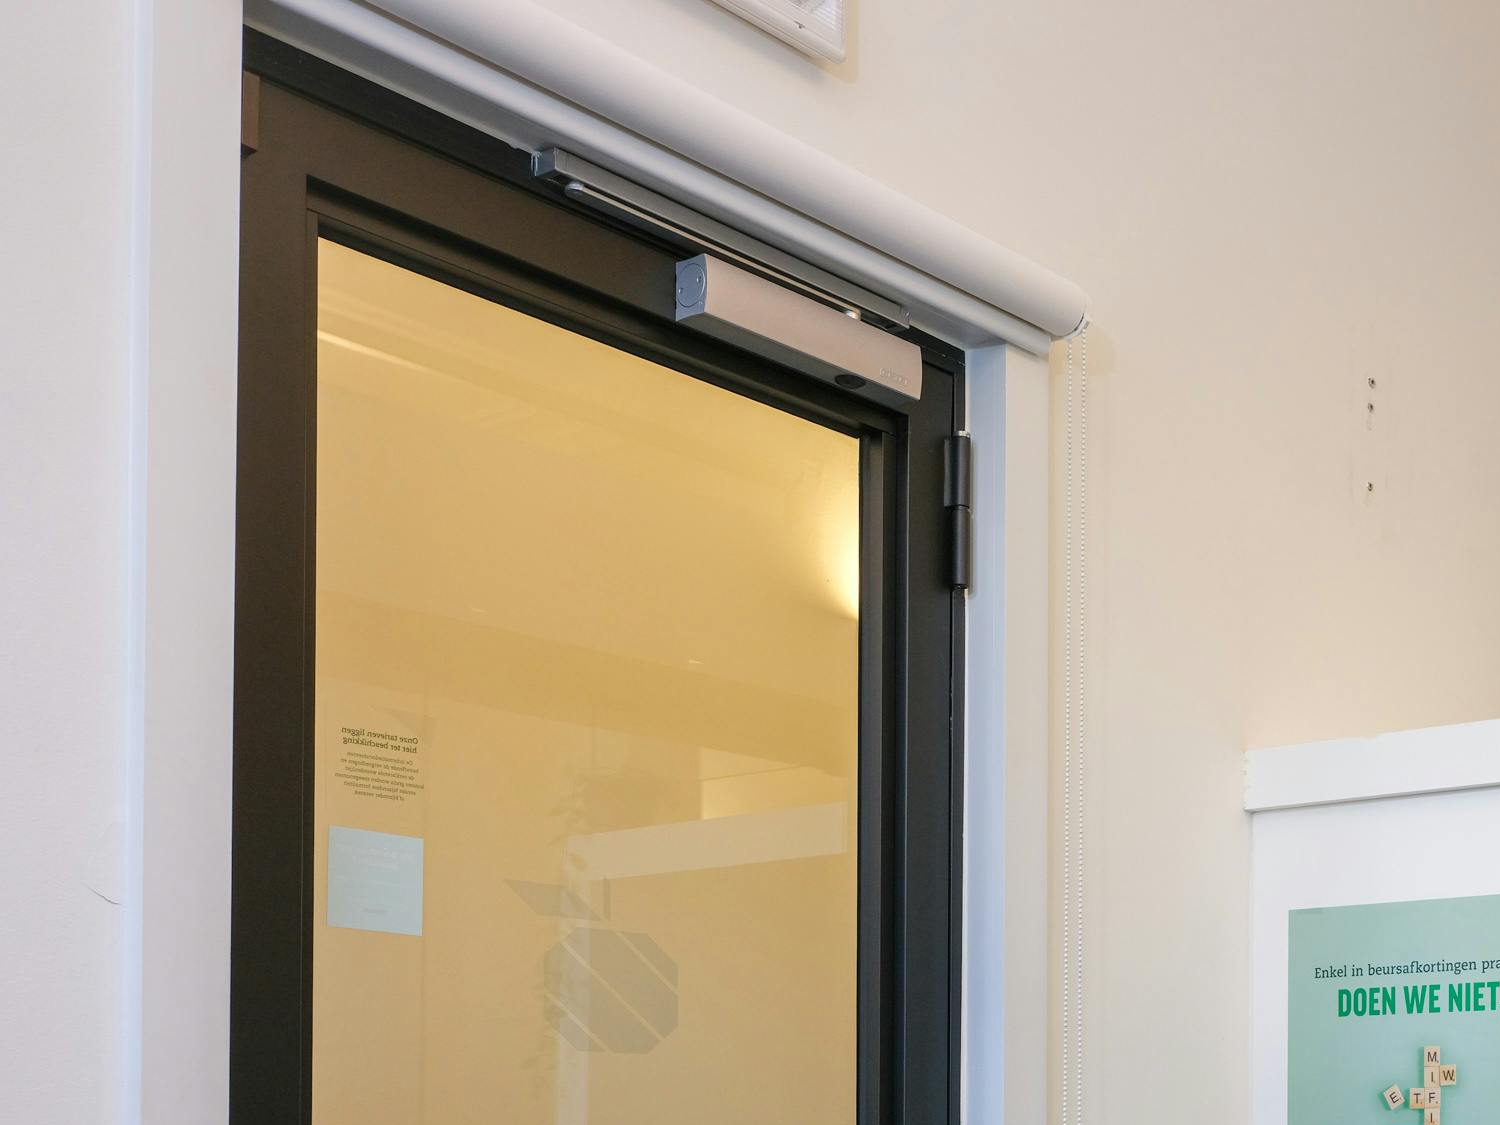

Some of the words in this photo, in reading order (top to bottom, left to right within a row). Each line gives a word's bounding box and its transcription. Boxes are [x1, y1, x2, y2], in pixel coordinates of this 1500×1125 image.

[1314, 965, 1347, 979] Enkel
[1351, 964, 1364, 977] in
[1368, 960, 1477, 975] beursafkortingen
[1338, 986, 1396, 1017] DOEN
[1403, 984, 1441, 1015] WE
